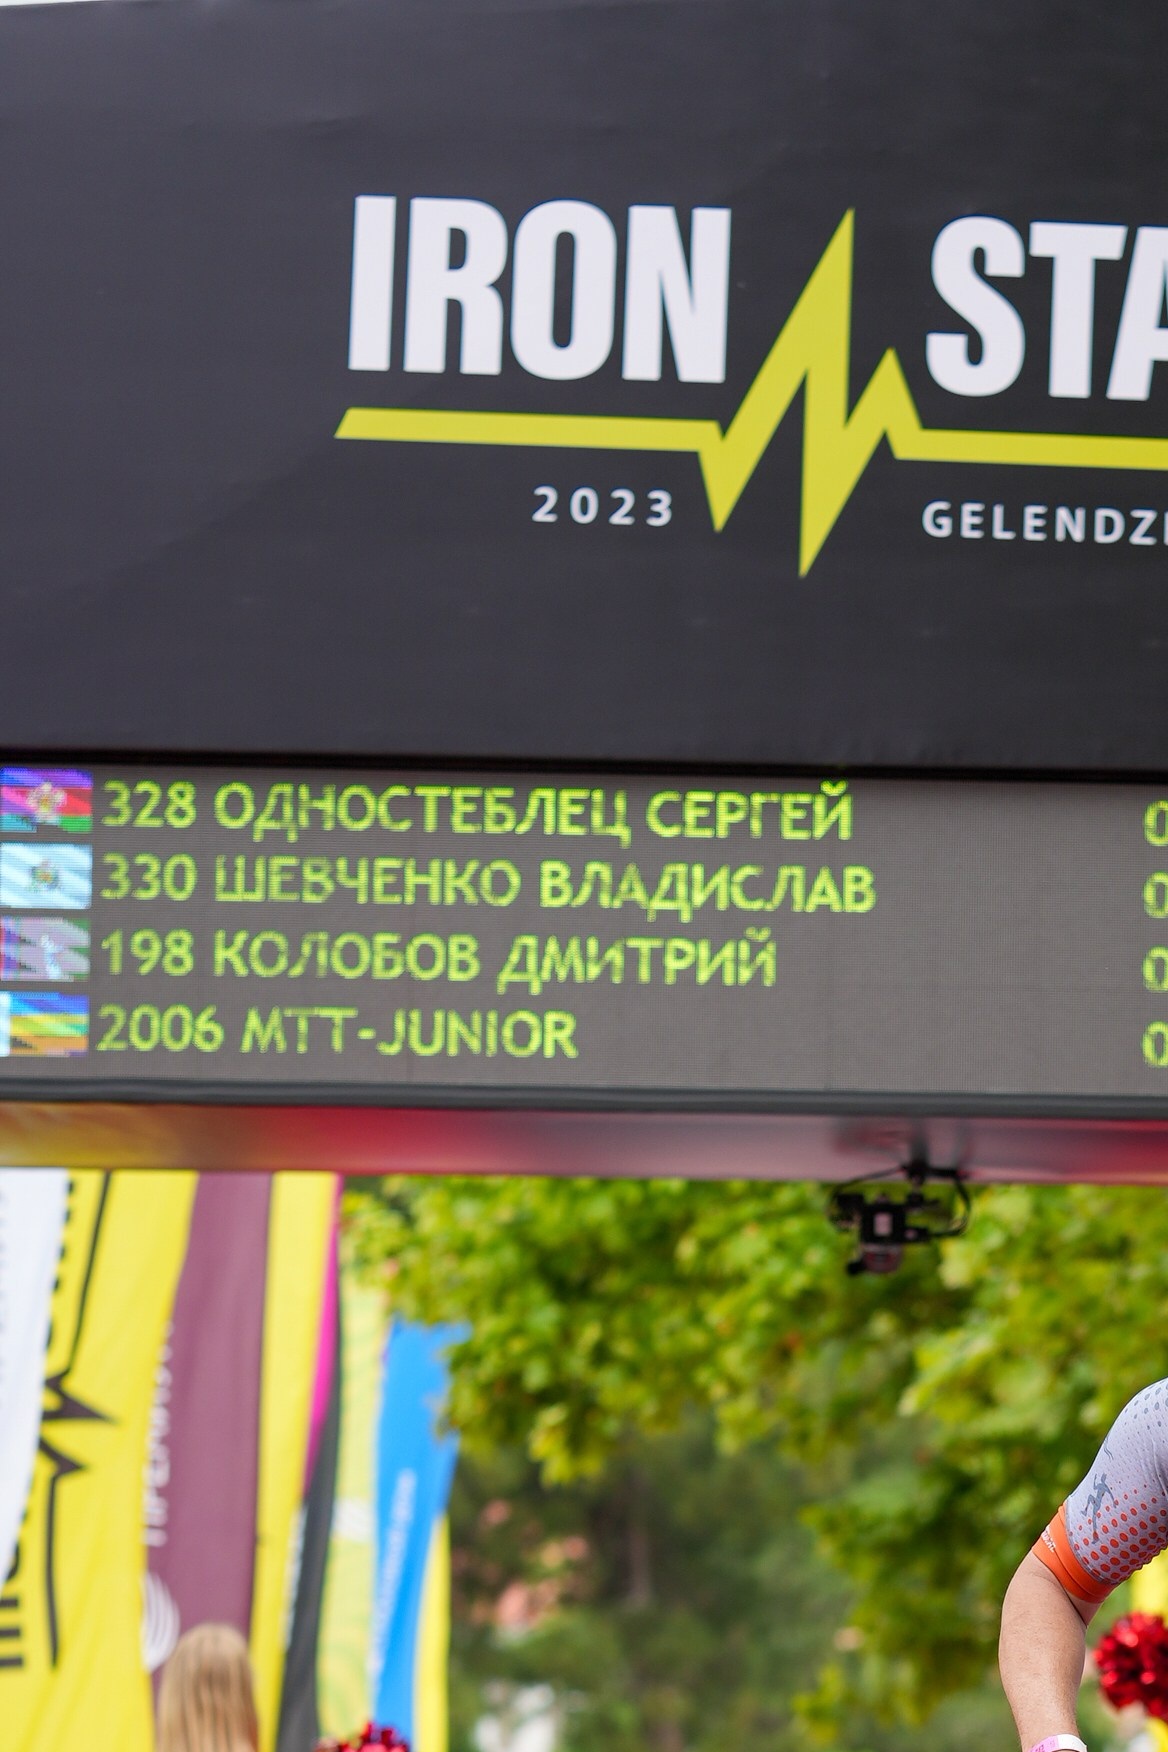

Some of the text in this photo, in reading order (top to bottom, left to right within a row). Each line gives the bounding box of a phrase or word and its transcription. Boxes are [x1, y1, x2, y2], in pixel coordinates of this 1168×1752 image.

[348, 195, 731, 381] IRON
[532, 485, 673, 527] 2023
[103, 779, 853, 848] 328 ОДНОСТЕБЛЕЦ СЕРГЕЙ
[101, 852, 877, 923] 330 ШЕВЧЕНКО ВЛАДИСЛАВ
[100, 926, 778, 995] 198 КОЛОБОВ ДМИТРИЙ
[97, 1004, 579, 1058] 2006 MTT-JUNIOR
